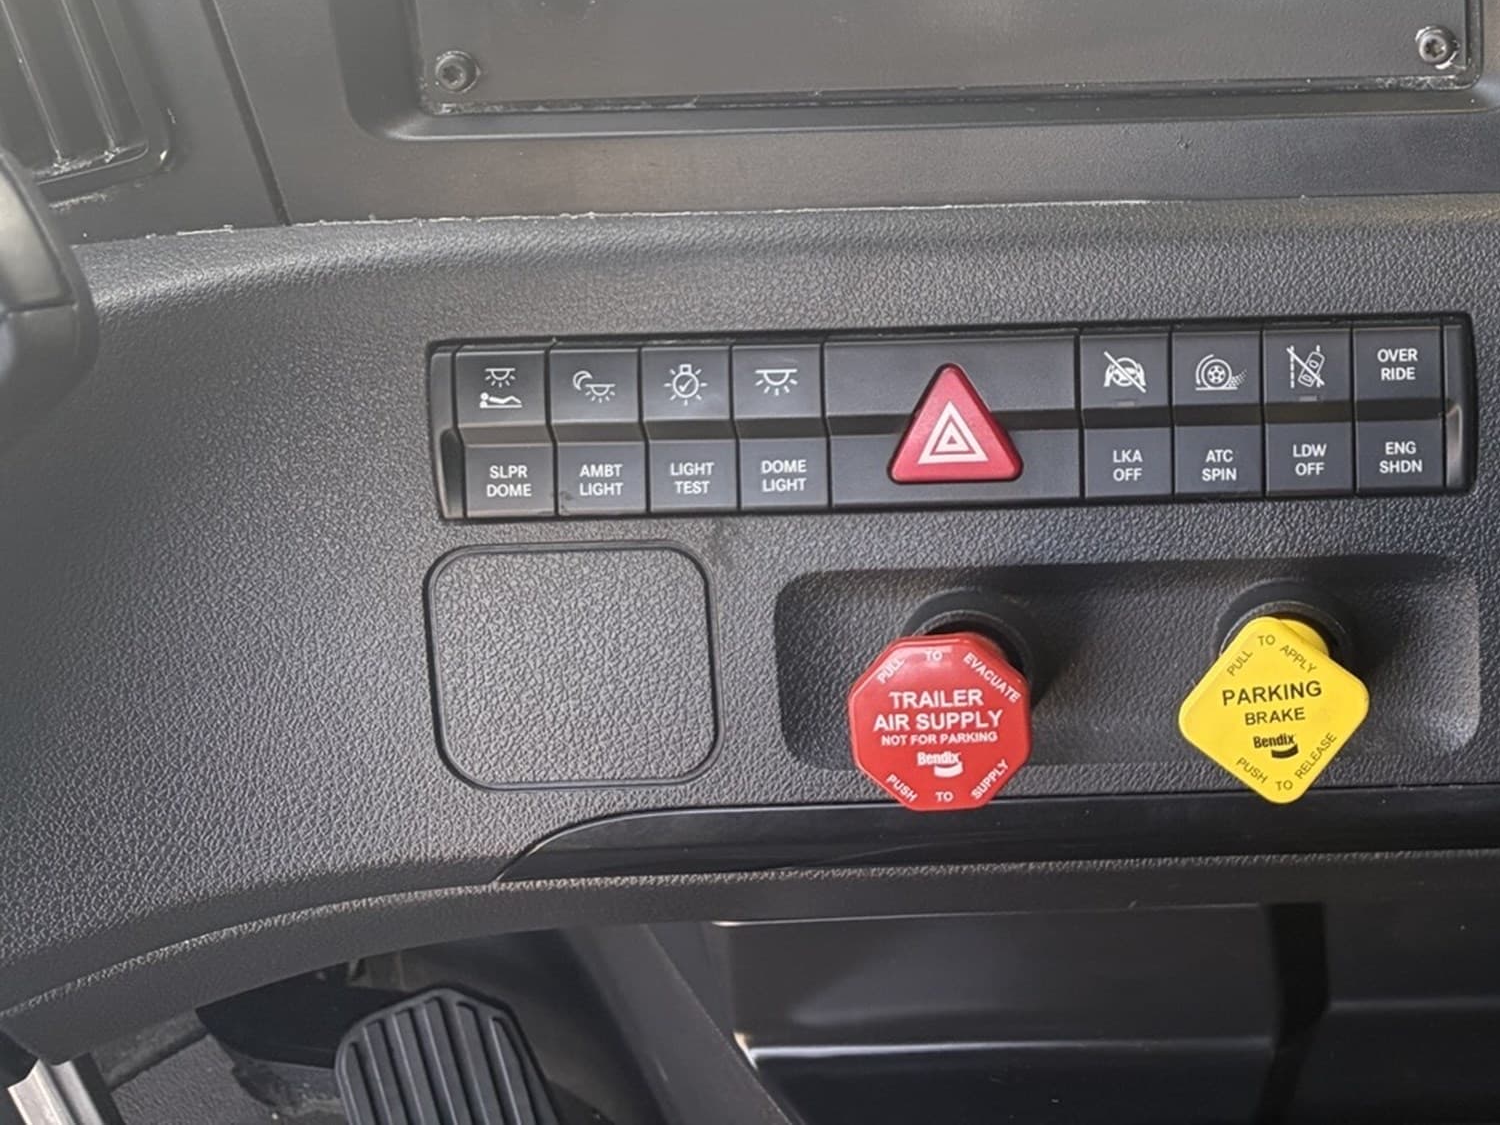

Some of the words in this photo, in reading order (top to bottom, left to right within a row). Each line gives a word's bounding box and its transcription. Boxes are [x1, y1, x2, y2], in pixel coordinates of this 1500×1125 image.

[1377, 348, 1418, 363] OVER
[1381, 366, 1416, 381] RIDE
[1292, 444, 1327, 459] LDW
[1384, 441, 1417, 456] ENG
[1113, 449, 1143, 464] LKA
[1205, 449, 1234, 464] ATC
[489, 465, 528, 480] SLPR
[579, 463, 623, 479] AMBT
[670, 462, 714, 477] LIGHT
[761, 459, 807, 475] DOME
[1113, 467, 1142, 482] OFF
[1201, 467, 1237, 482] SPIN
[1295, 461, 1325, 476] OFF
[1379, 459, 1423, 475] SHDN
[486, 483, 532, 498] DOME
[579, 481, 624, 497] LIGHT
[674, 480, 711, 495] TEST
[762, 477, 807, 493] LIGHT
[1227, 649, 1253, 676] PULL
[1258, 634, 1276, 646] TO
[1280, 644, 1318, 674] APPLY
[876, 657, 905, 685] PULL
[924, 649, 943, 661] TO
[963, 652, 1021, 704] EVACUATE
[889, 689, 984, 709] TRAILER
[1222, 680, 1322, 706] PARKING
[873, 714, 910, 731] AIR
[915, 709, 1003, 730] SUPPLY
[1244, 706, 1305, 726] BRAKE
[881, 734, 907, 746] NOT
[910, 733, 936, 745] FOR
[939, 731, 998, 744] PARKING
[1253, 733, 1295, 749] Bendix
[916, 751, 961, 766] Bendix
[1236, 757, 1268, 784] PUSH
[1275, 780, 1293, 791] TO
[1295, 732, 1338, 780] RELEASE
[886, 774, 918, 802] PUSH
[935, 791, 954, 803] TO
[971, 759, 1009, 800] SUPPLY
